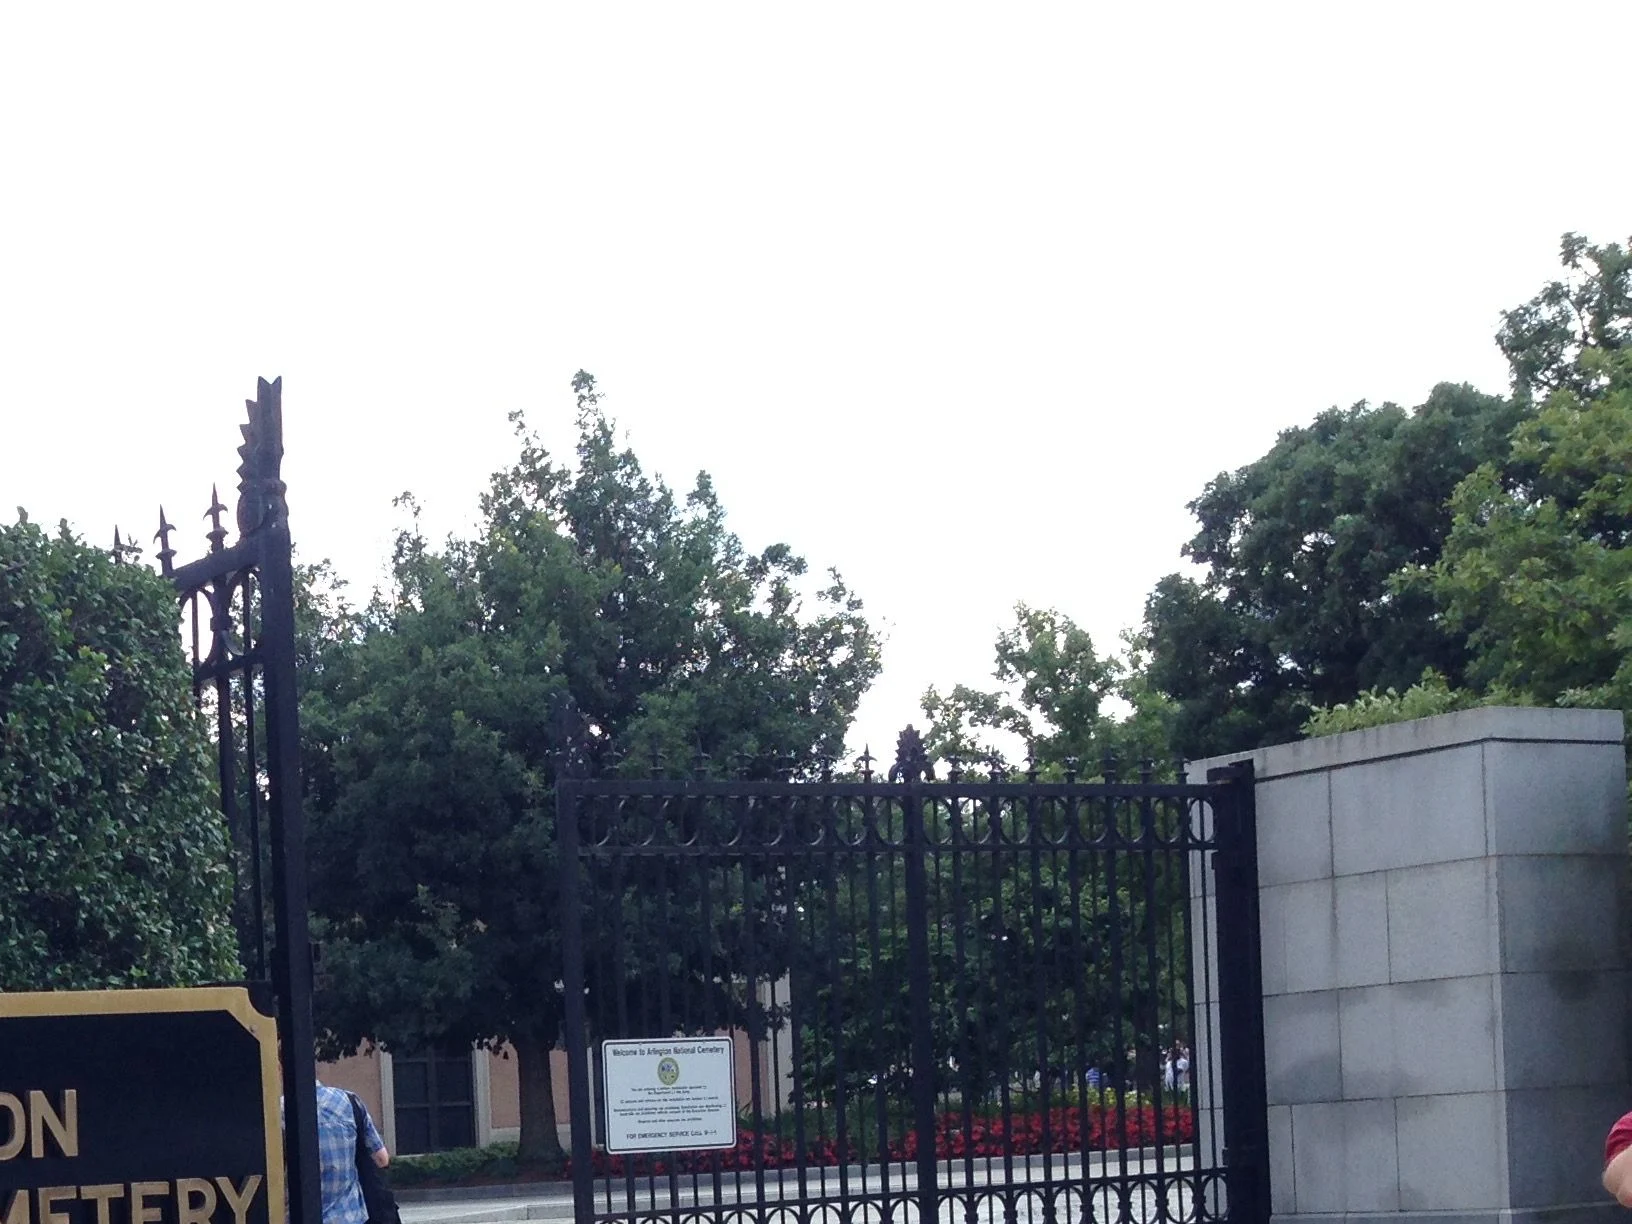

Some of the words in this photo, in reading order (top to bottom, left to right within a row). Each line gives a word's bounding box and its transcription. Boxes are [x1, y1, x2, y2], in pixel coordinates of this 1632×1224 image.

[612, 1048, 637, 1057] Welcome
[639, 1048, 646, 1056] to
[647, 1047, 672, 1057] Arlington
[673, 1046, 696, 1055] National
[697, 1045, 725, 1054] Cemetery
